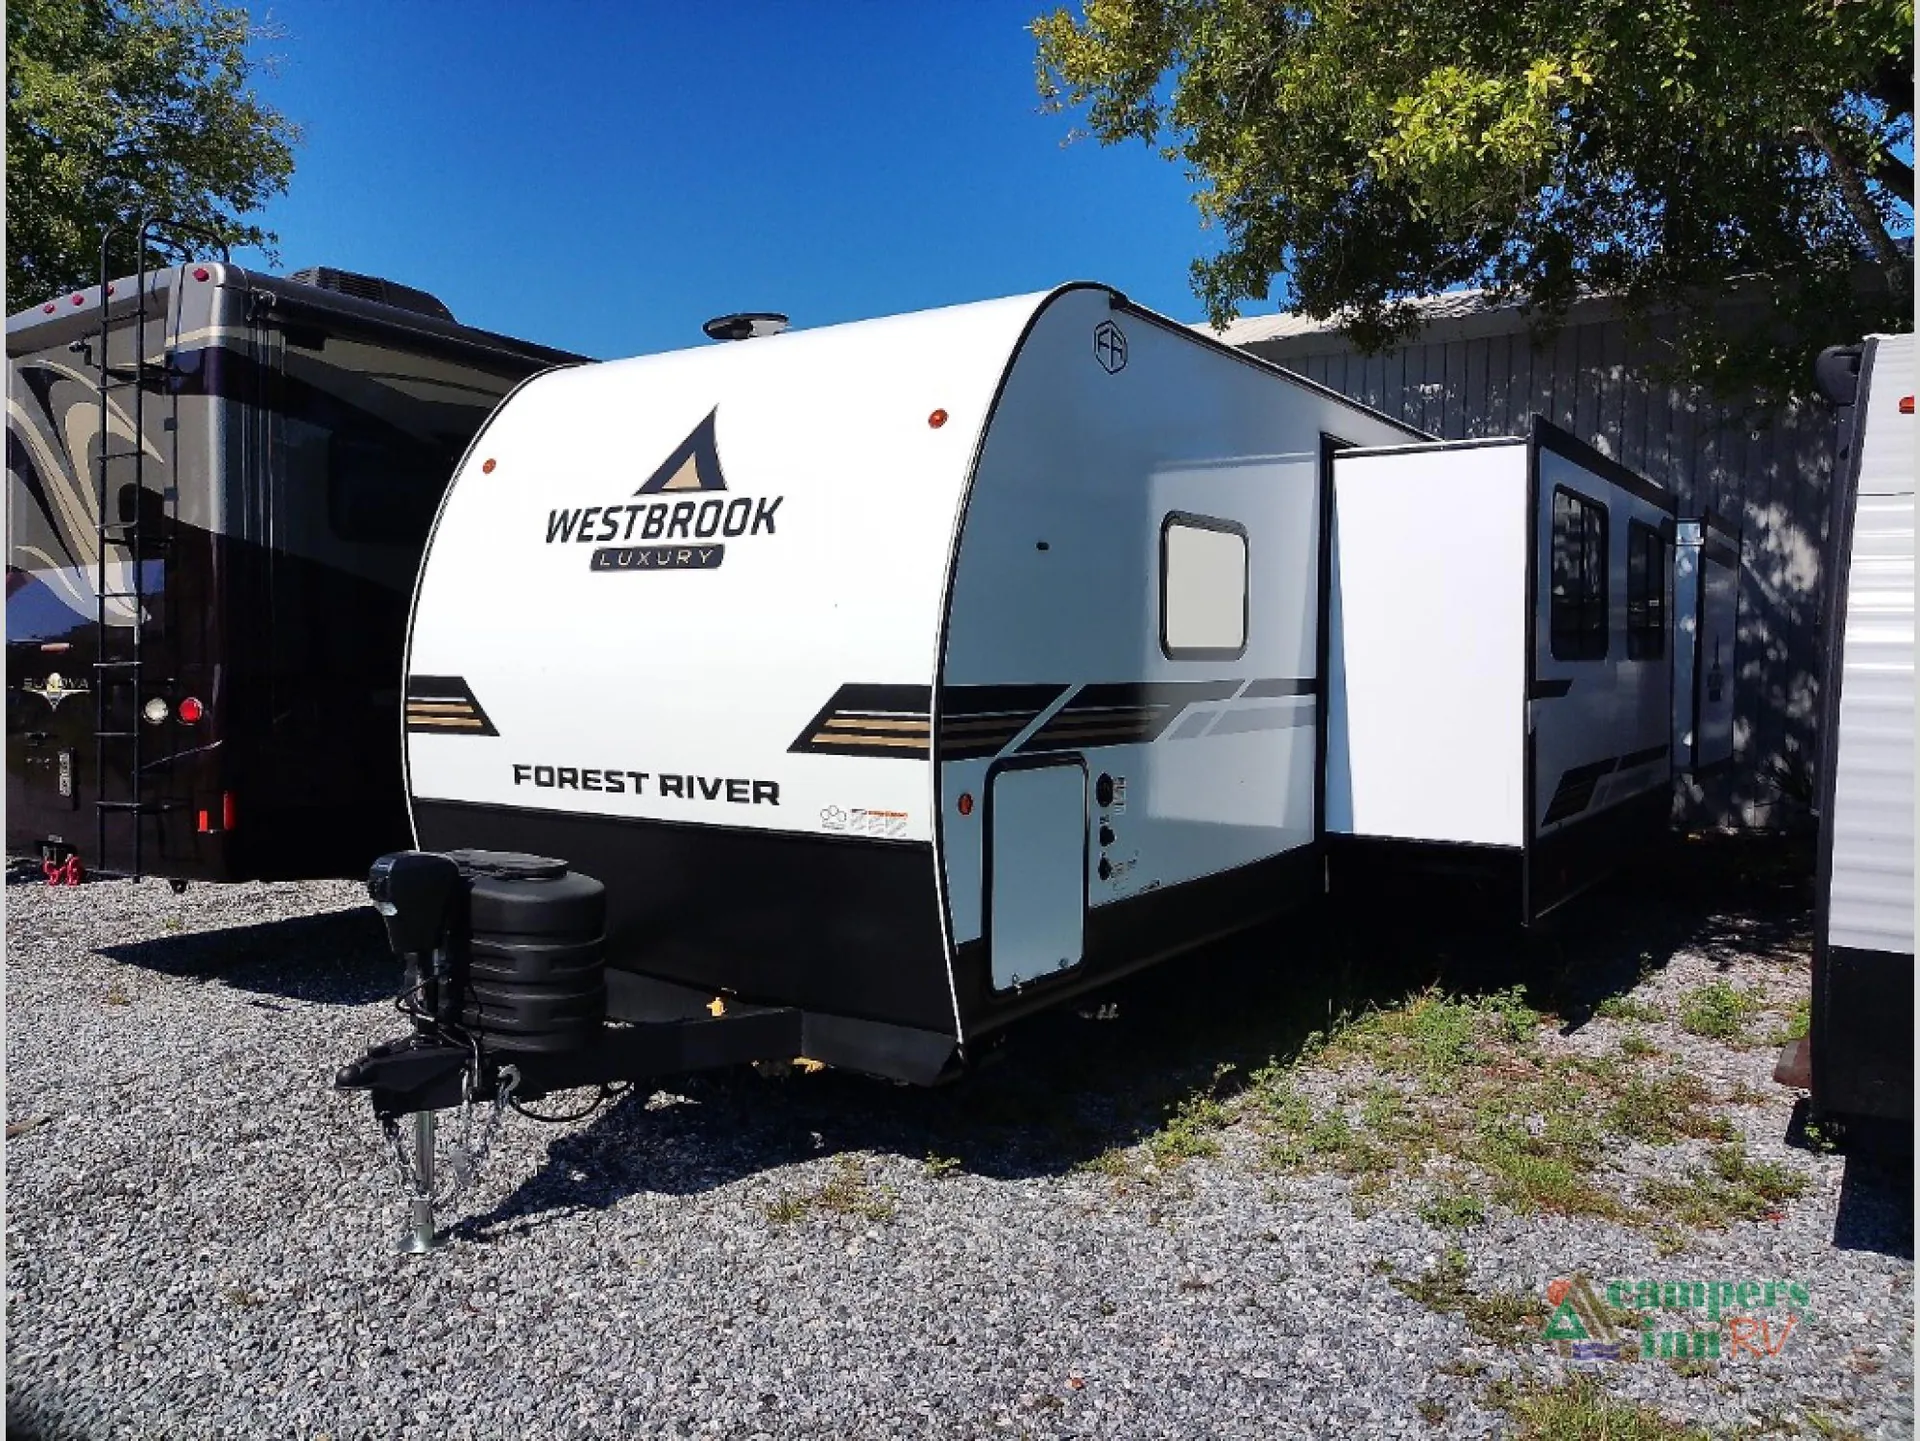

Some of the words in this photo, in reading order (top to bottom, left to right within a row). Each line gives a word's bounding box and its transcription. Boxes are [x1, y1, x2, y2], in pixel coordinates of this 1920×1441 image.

[546, 496, 784, 543] WESTBROOK
[599, 549, 713, 566] LUXURY
[512, 764, 650, 795] FOREST
[657, 773, 780, 806] RIVER
